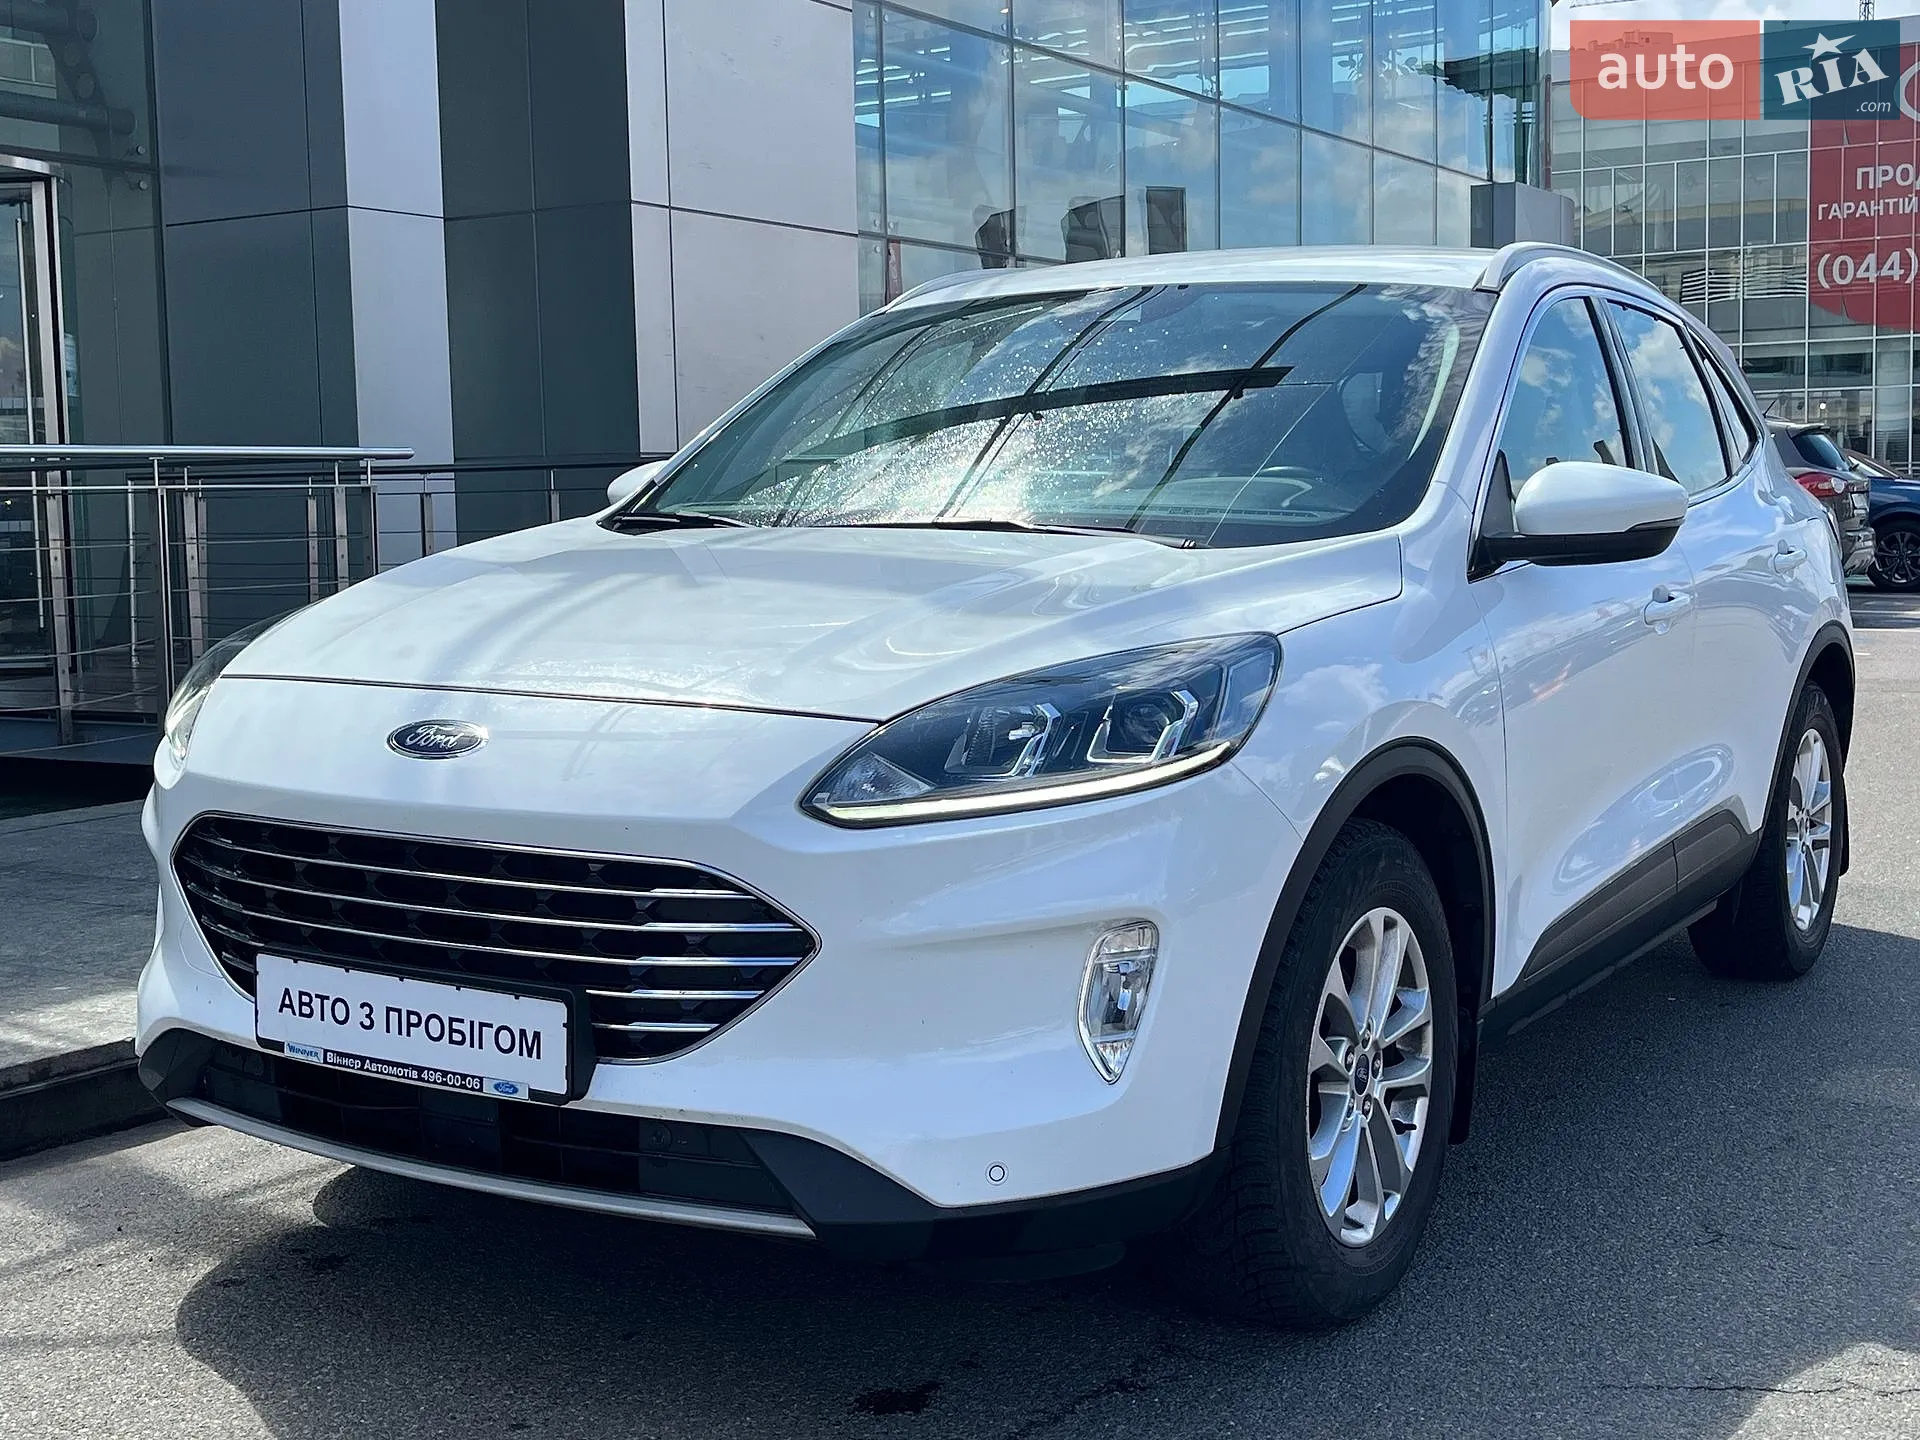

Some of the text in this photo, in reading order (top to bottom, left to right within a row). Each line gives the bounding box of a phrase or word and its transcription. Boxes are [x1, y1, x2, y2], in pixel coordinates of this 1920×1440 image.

[1817, 193, 1919, 220] ГАРАНТІЙ
[1817, 247, 1919, 289] (044)
[405, 724, 464, 749] Ford
[278, 987, 350, 1026] АВТО
[385, 1006, 542, 1060] ПРОБІГОМ
[326, 1051, 480, 1090] Віннер Автомотів 496-00-06
